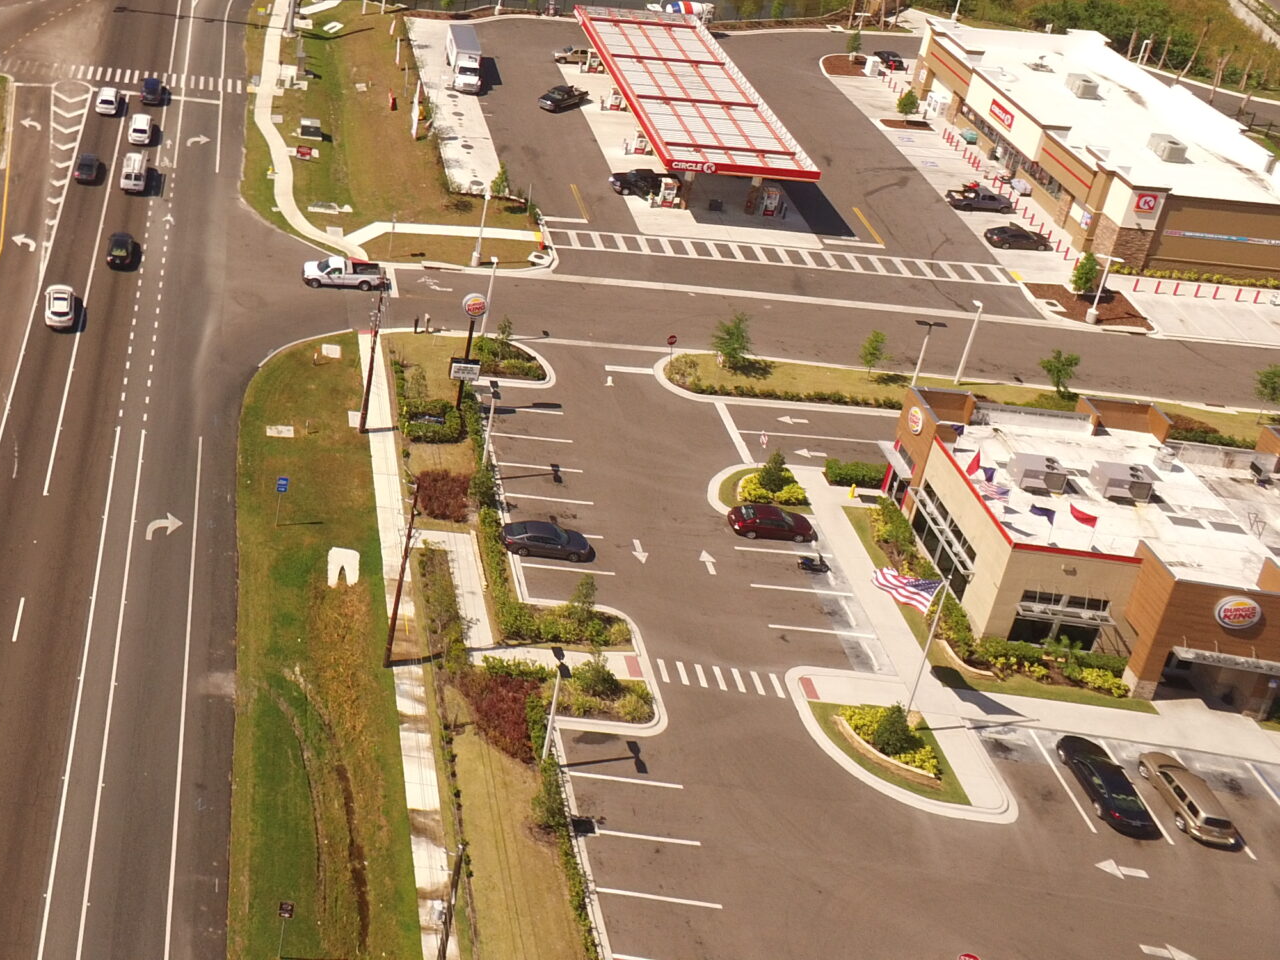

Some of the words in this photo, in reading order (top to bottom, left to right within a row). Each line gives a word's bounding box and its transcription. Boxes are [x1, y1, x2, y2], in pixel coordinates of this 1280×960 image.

[672, 161, 703, 171] CIRCLE
[704, 163, 715, 174] K
[467, 305, 486, 313] KING
[1223, 606, 1257, 614] BURGER
[1222, 611, 1257, 620] KING
